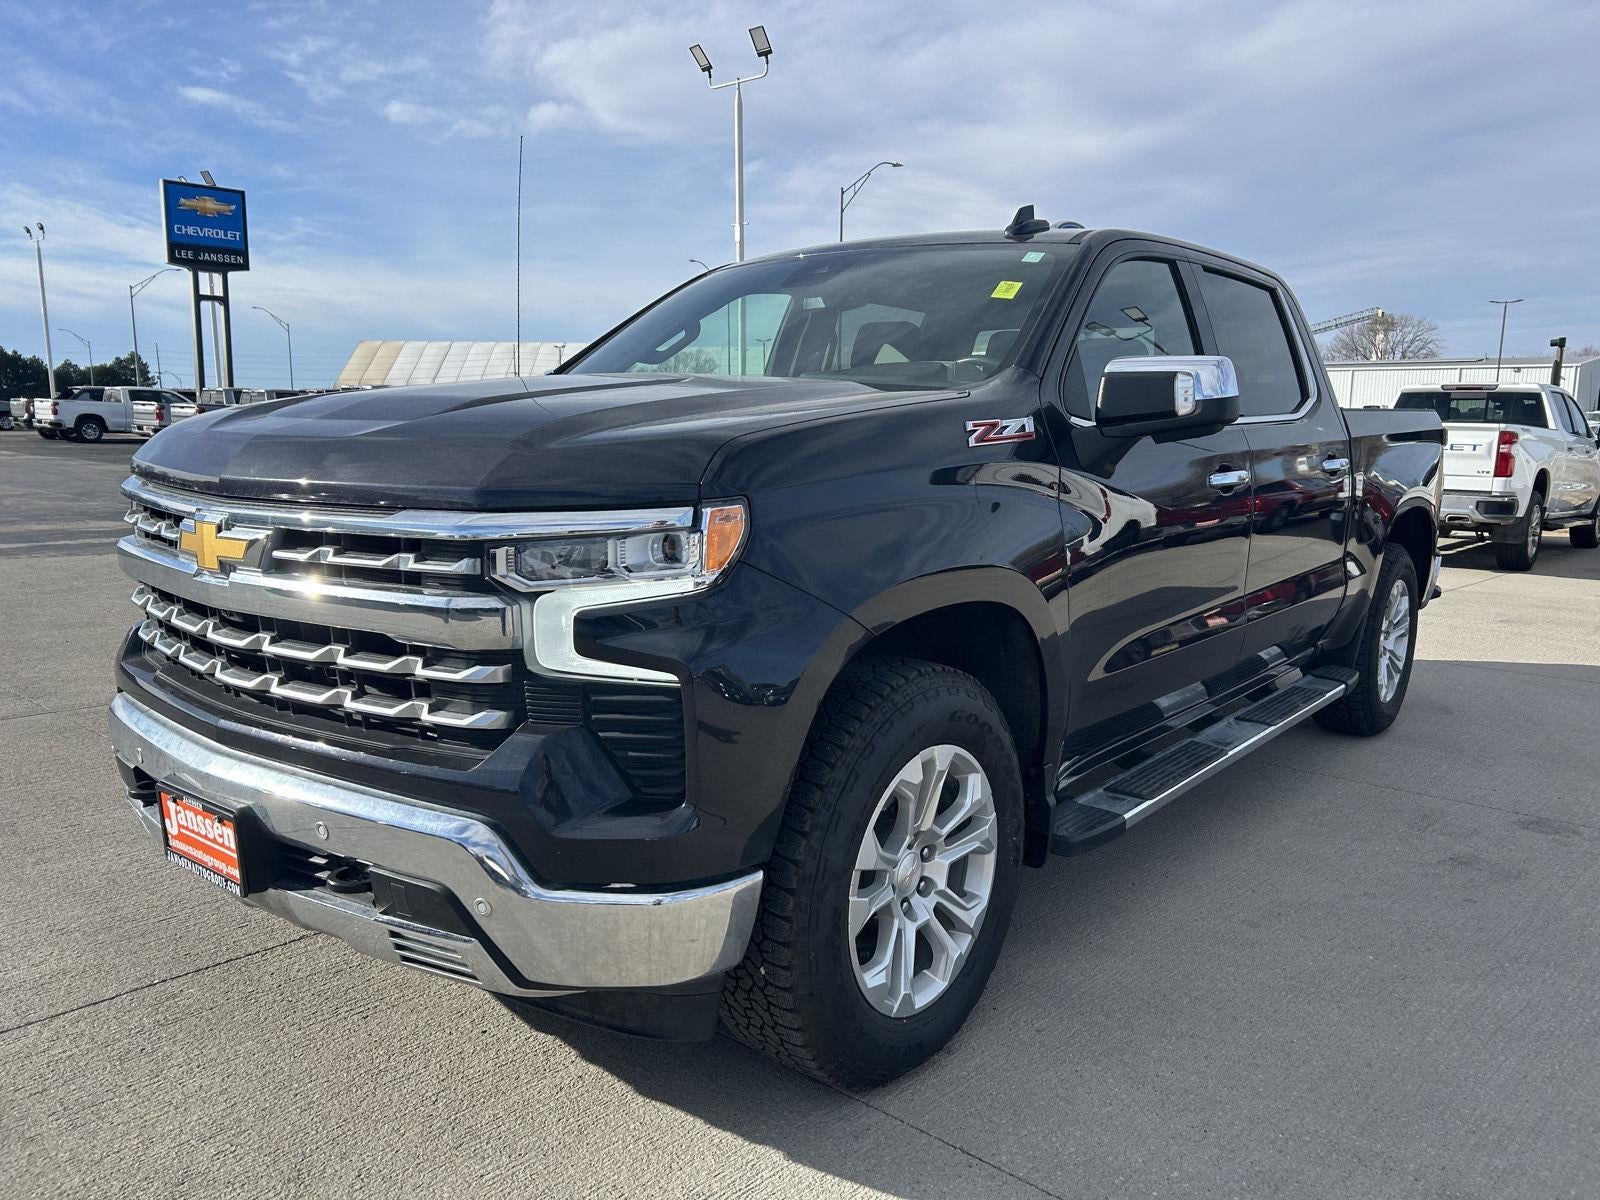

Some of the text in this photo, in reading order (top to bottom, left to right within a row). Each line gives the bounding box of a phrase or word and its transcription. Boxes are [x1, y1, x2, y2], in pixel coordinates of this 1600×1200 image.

[174, 224, 241, 241] CHEVROLET
[175, 249, 244, 264] LEE JANSSEN
[965, 416, 1036, 448] Z71
[165, 800, 236, 849] Janssen
